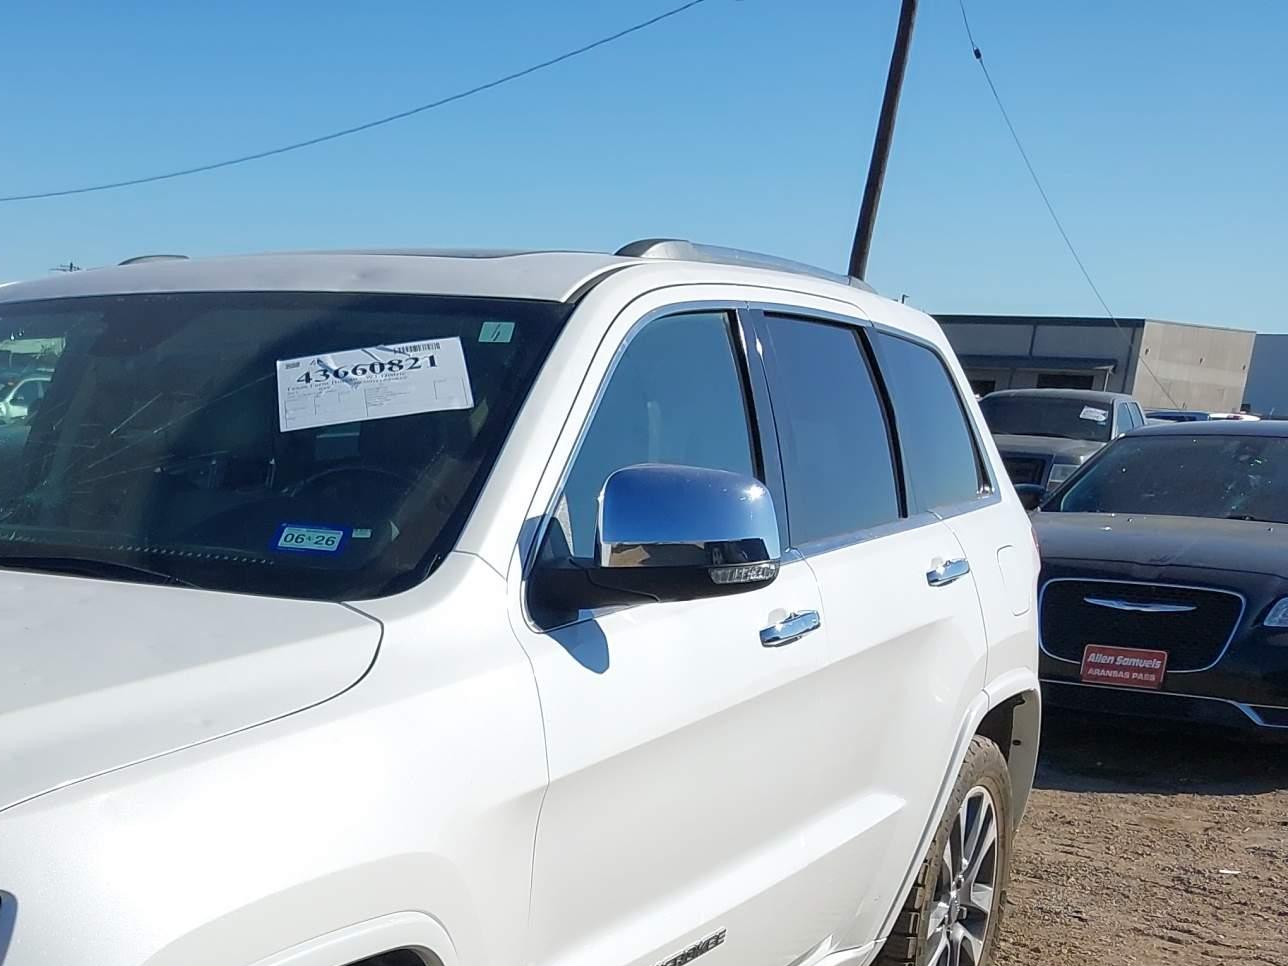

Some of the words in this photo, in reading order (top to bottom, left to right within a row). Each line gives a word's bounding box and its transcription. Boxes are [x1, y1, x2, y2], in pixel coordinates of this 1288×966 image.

[296, 354, 439, 385] 43660821
[282, 532, 306, 545] 06
[313, 534, 337, 547] 26
[1087, 652, 1114, 664] Allen
[1115, 655, 1162, 669] Samuels
[1087, 667, 1130, 679] ARANSAS
[1131, 672, 1156, 681] PASS
